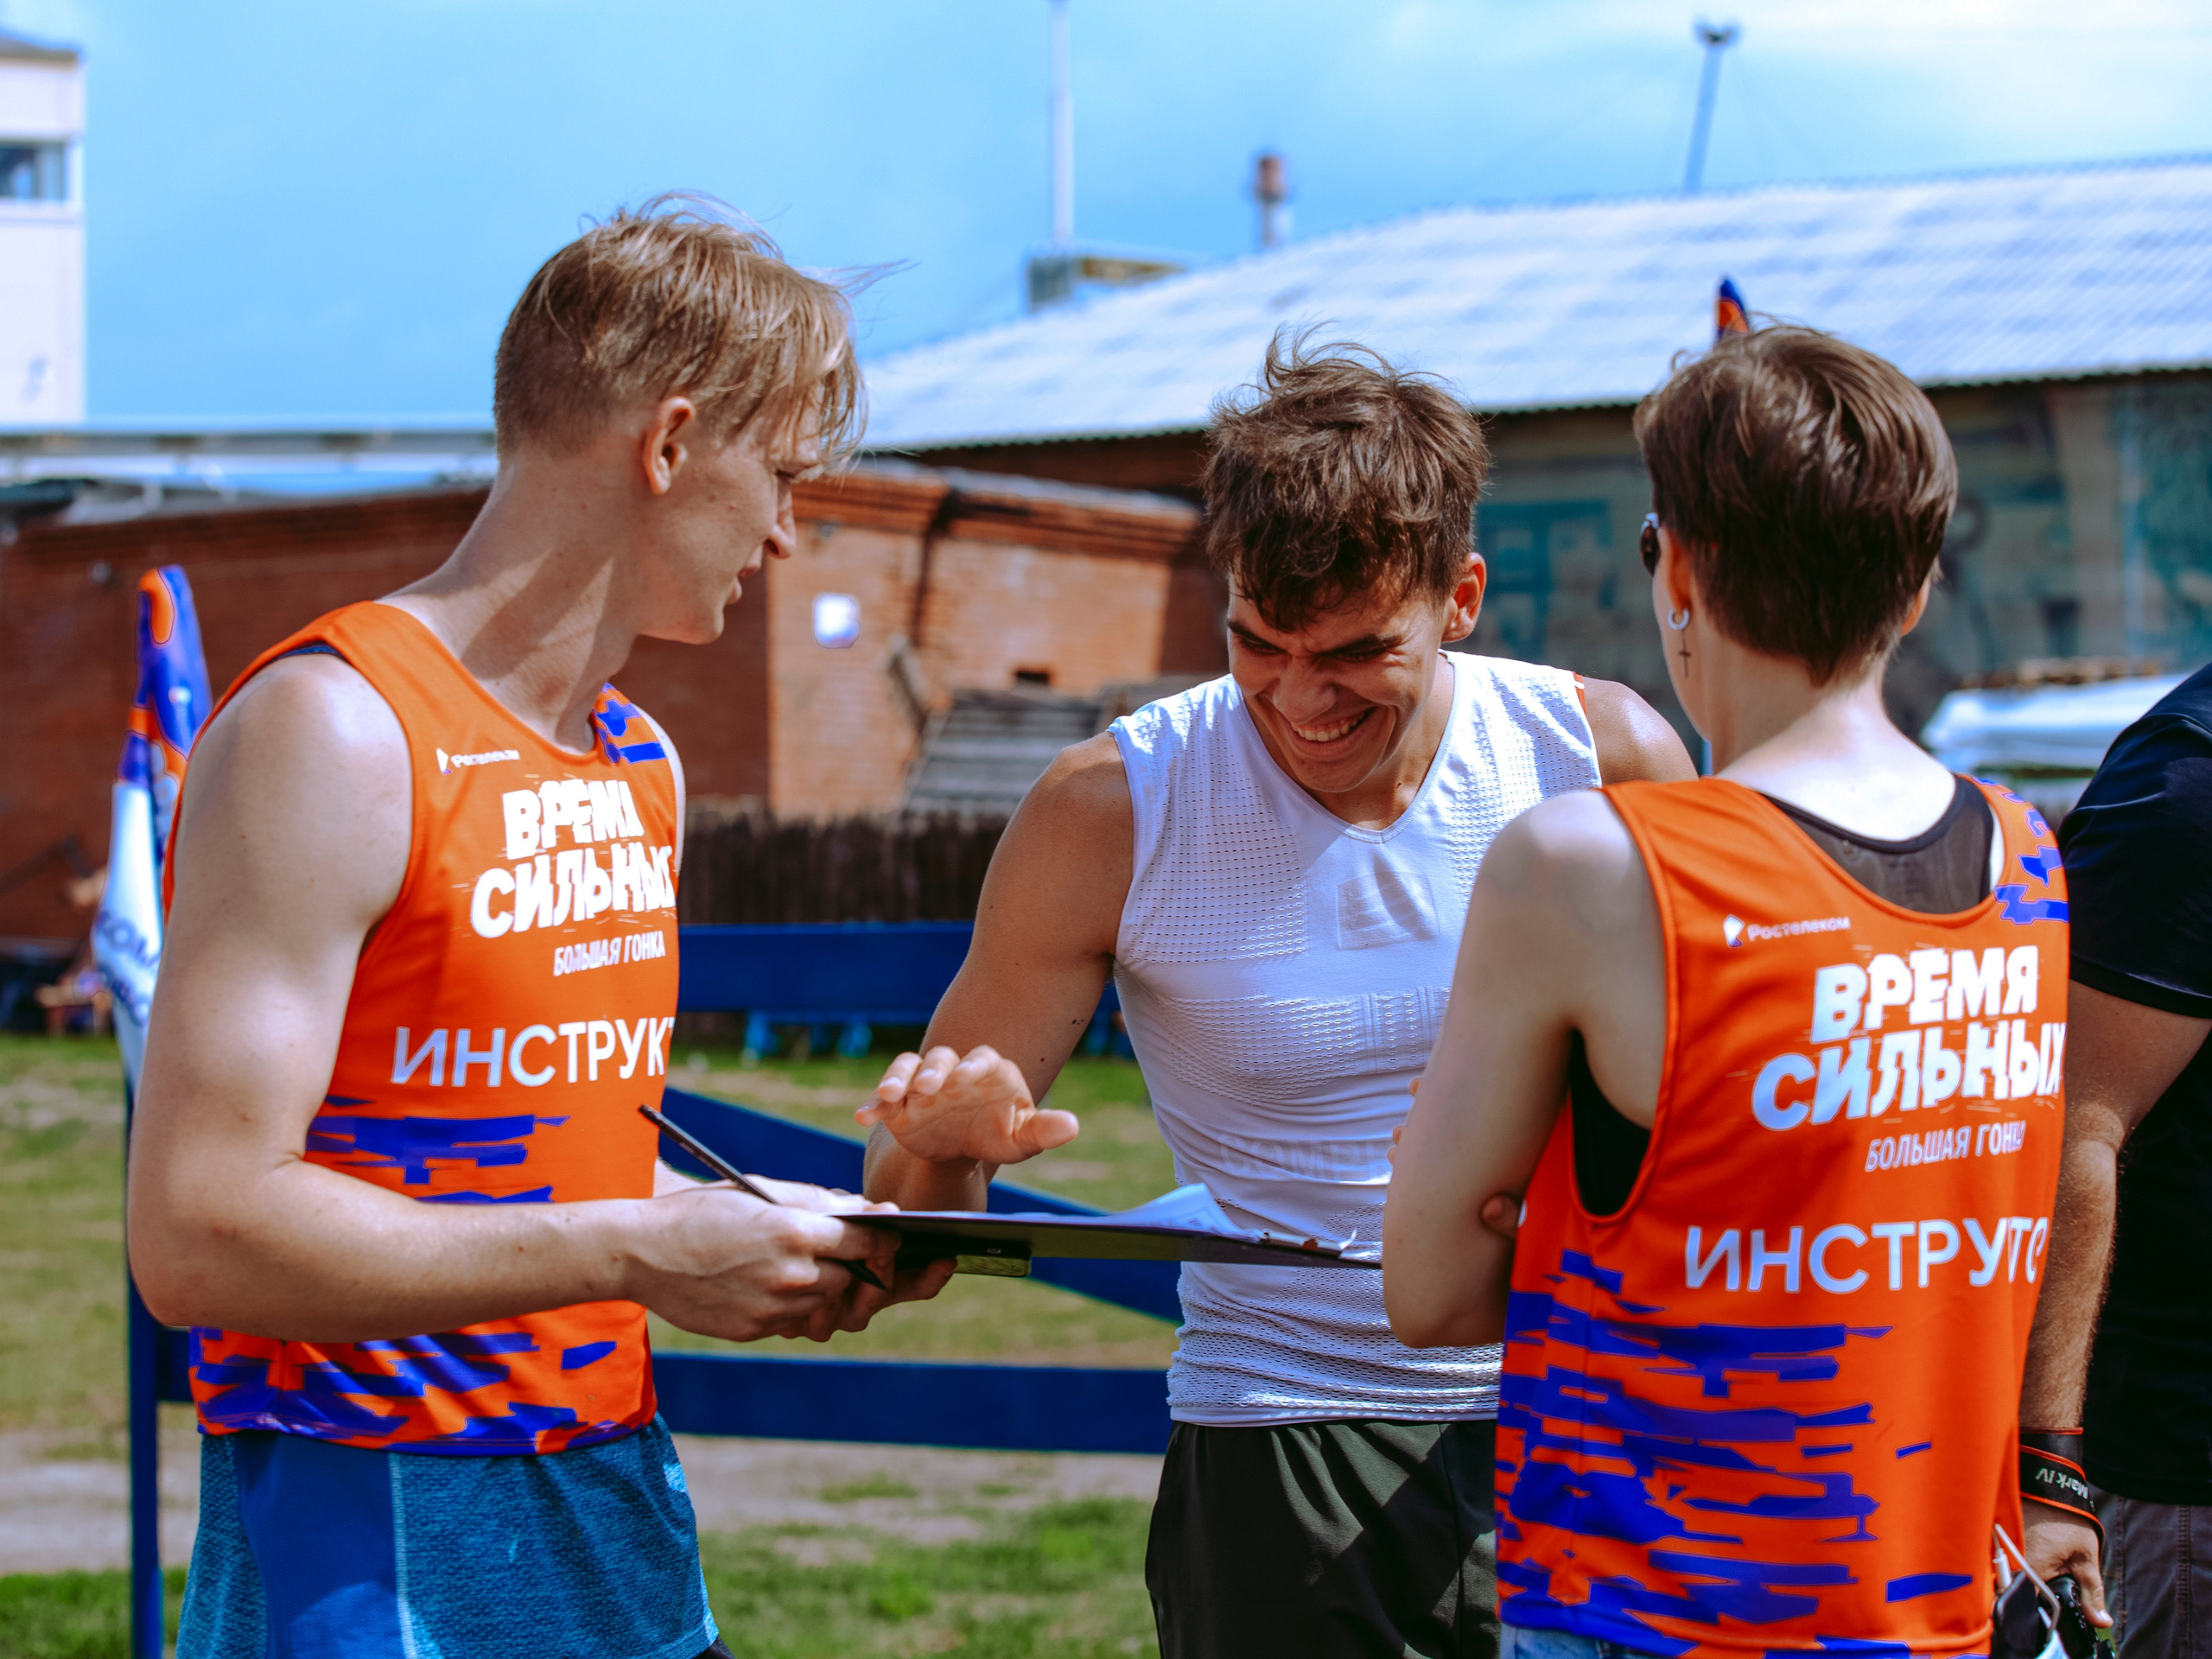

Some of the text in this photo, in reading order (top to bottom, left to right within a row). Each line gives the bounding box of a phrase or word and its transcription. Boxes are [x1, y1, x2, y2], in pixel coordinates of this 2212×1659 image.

[1746, 916, 1851, 942] Ростелеком
[553, 930, 666, 977] БОЛЬШАЯ ГОНКА
[1810, 945, 2039, 1045] ВРЕМЯ
[1751, 1019, 2066, 1132] СИЛЬНЫХ
[1865, 1125, 1971, 1173] БОЛЬШАЯ
[2034, 1467, 2088, 1499] Mark IV
